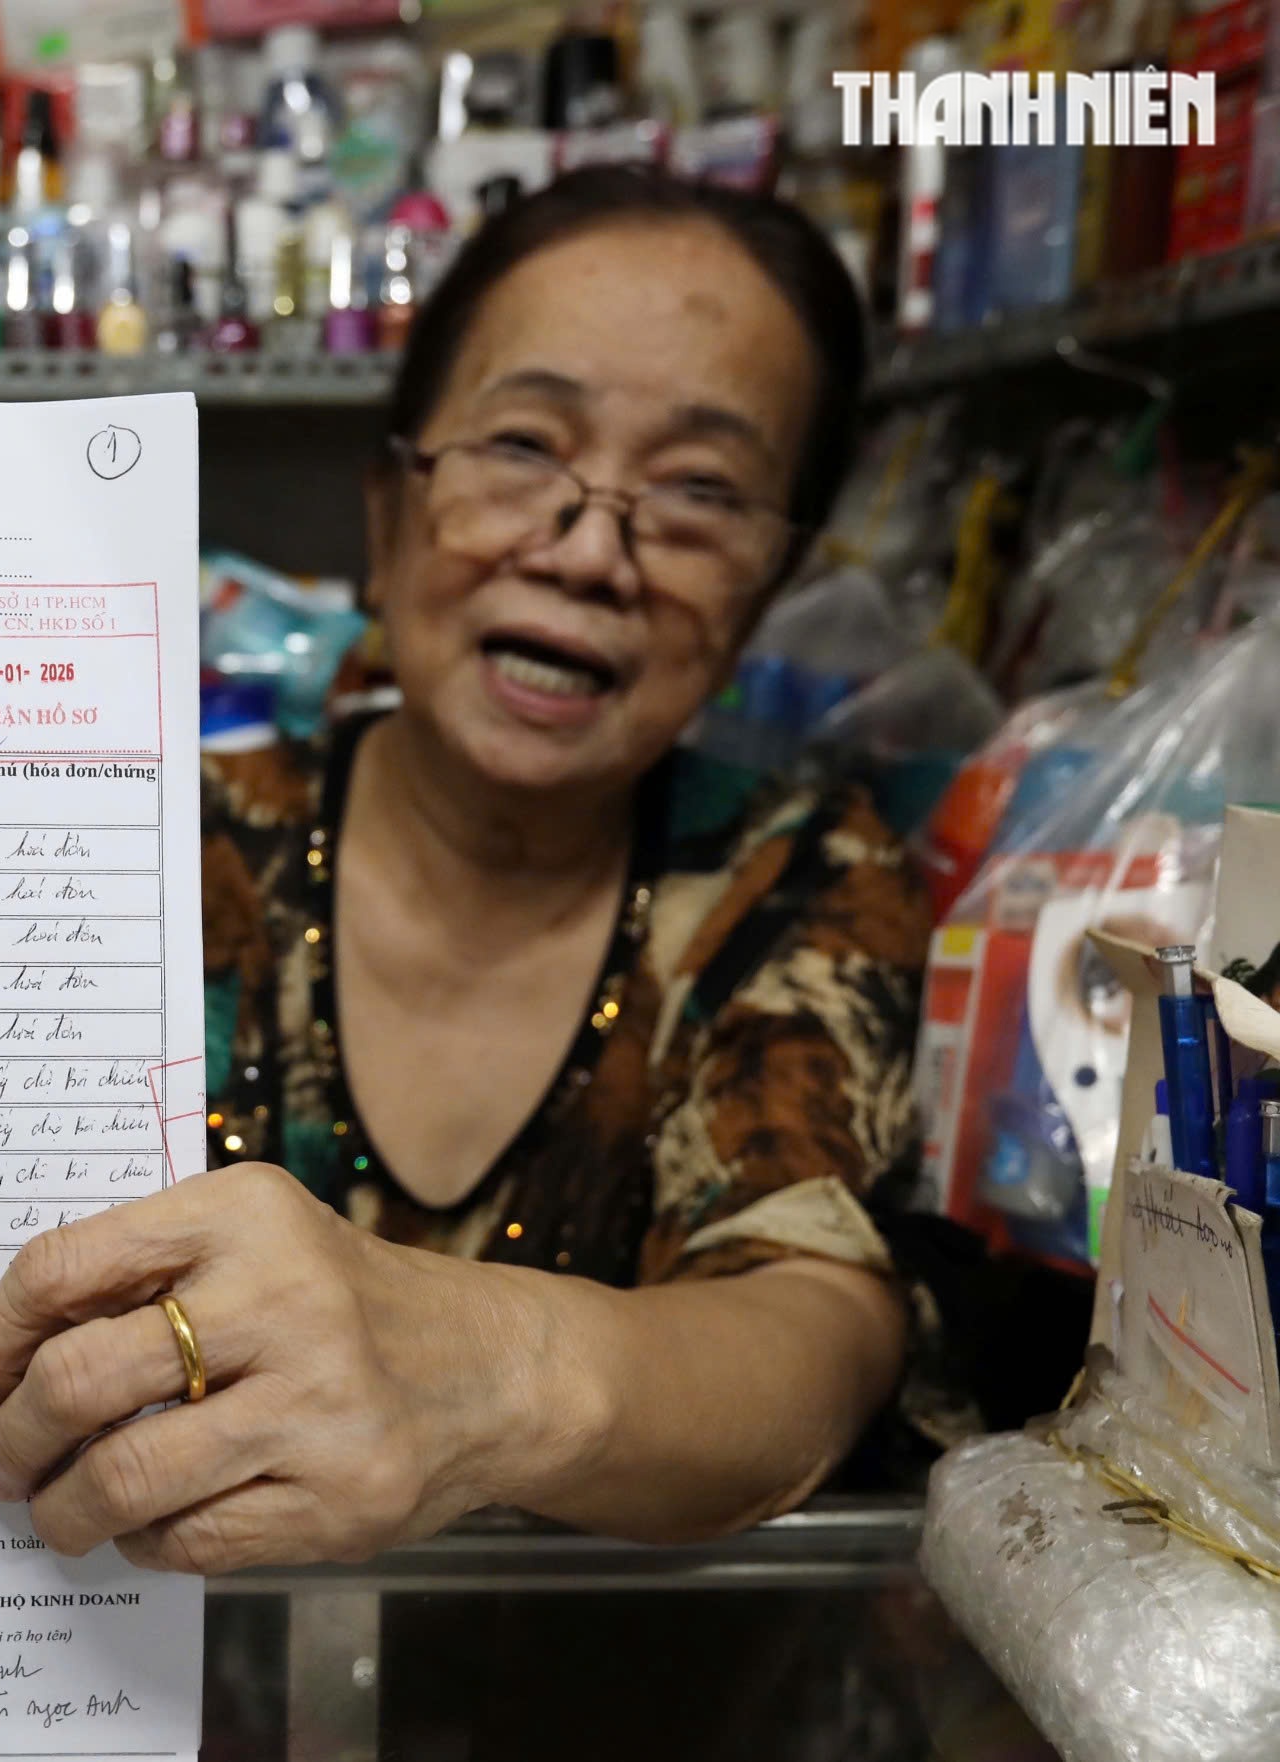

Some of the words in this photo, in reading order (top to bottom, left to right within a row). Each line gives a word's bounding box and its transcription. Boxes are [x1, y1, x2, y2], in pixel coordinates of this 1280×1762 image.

[106, 431, 117, 464] 1
[25, 596, 39, 609] 14
[46, 596, 106, 609] TP.HCM
[39, 618, 77, 630] HKD
[39, 662, 75, 684] 2026
[22, 762, 63, 781] (hóa
[0, 1593, 26, 1611] HỘ
[30, 1594, 75, 1607] KINH
[78, 1593, 141, 1606] DOANH
[6, 1630, 23, 1643] rõ
[25, 1629, 44, 1644] họ
[46, 1628, 73, 1644] tên)
